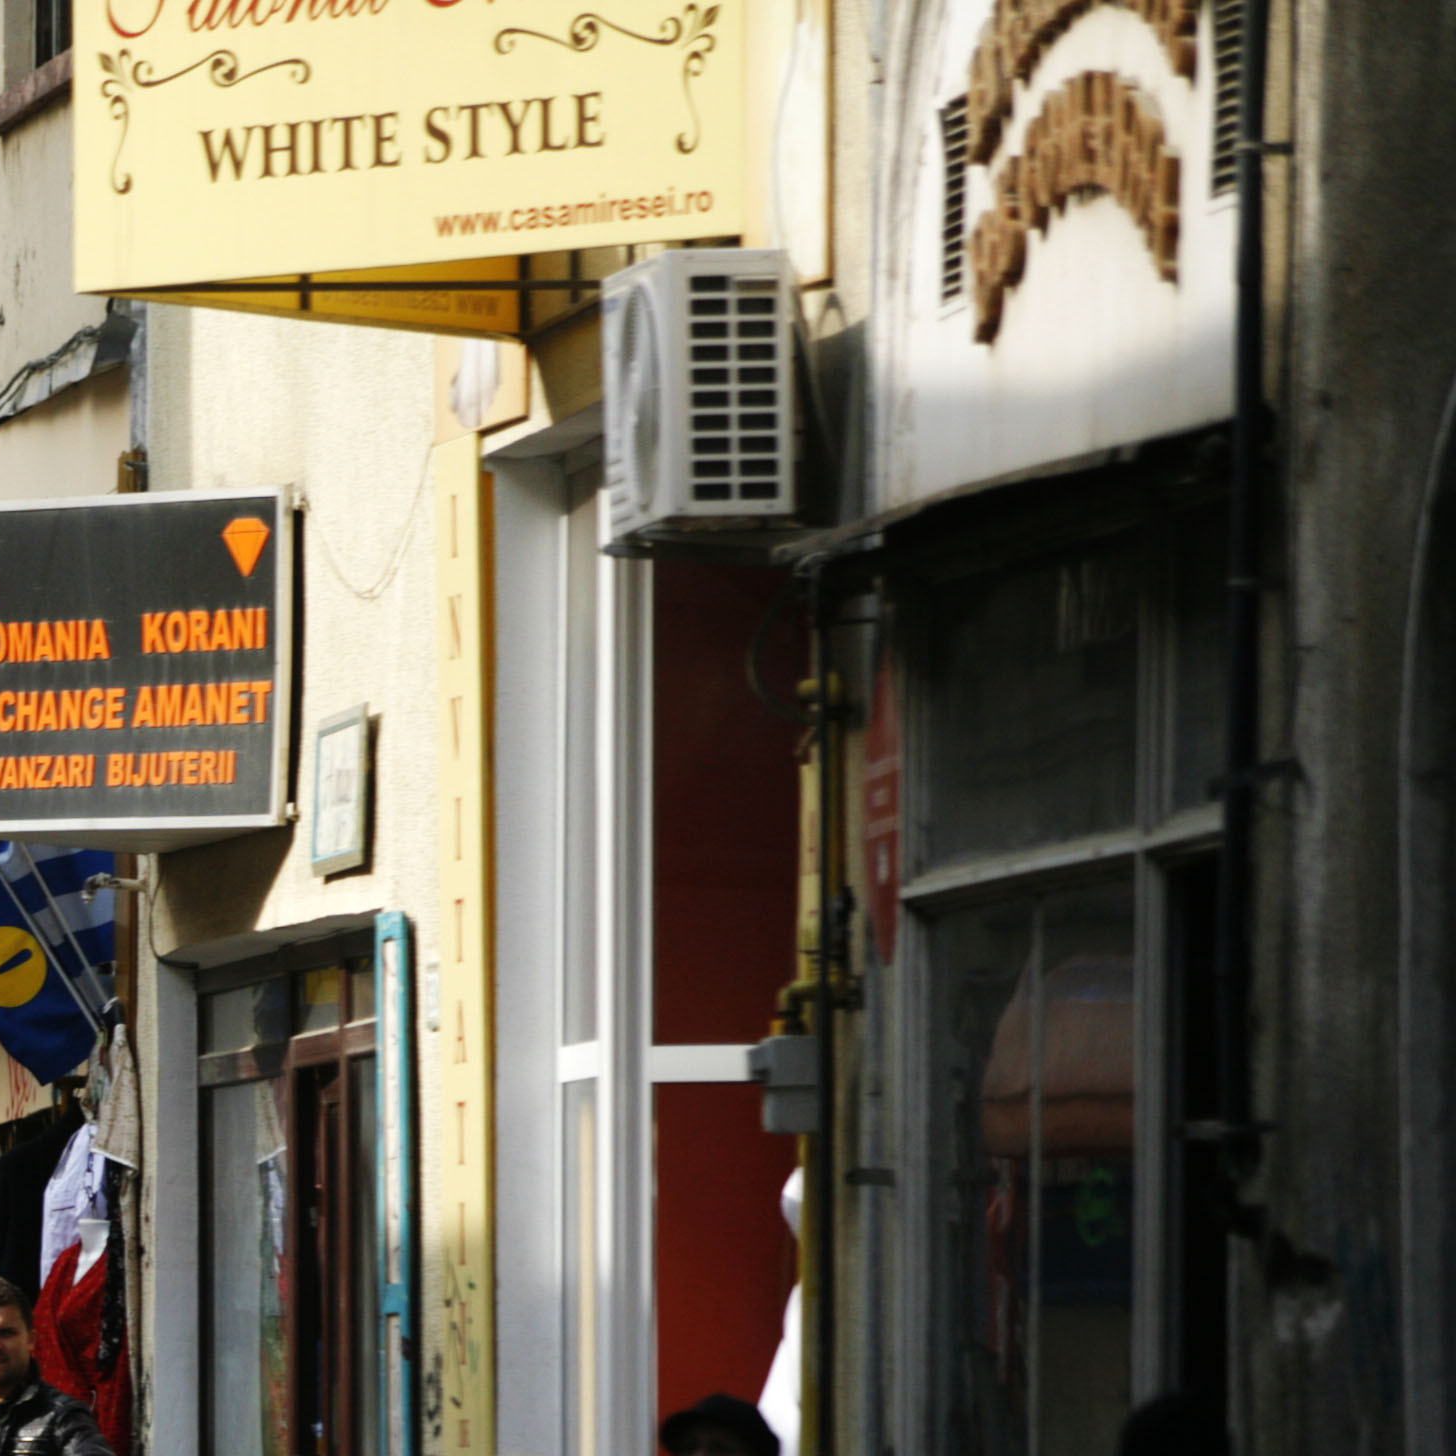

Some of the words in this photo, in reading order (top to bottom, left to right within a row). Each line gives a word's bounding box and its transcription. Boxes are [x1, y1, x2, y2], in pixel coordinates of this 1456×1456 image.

[198, 111, 402, 184] WHITE
[422, 91, 606, 165] STYLE
[434, 186, 715, 238] www.casamiresei.ro
[141, 607, 268, 655] KORANI
[131, 679, 274, 728] AMANET
[105, 749, 238, 788] BIJUTERII
